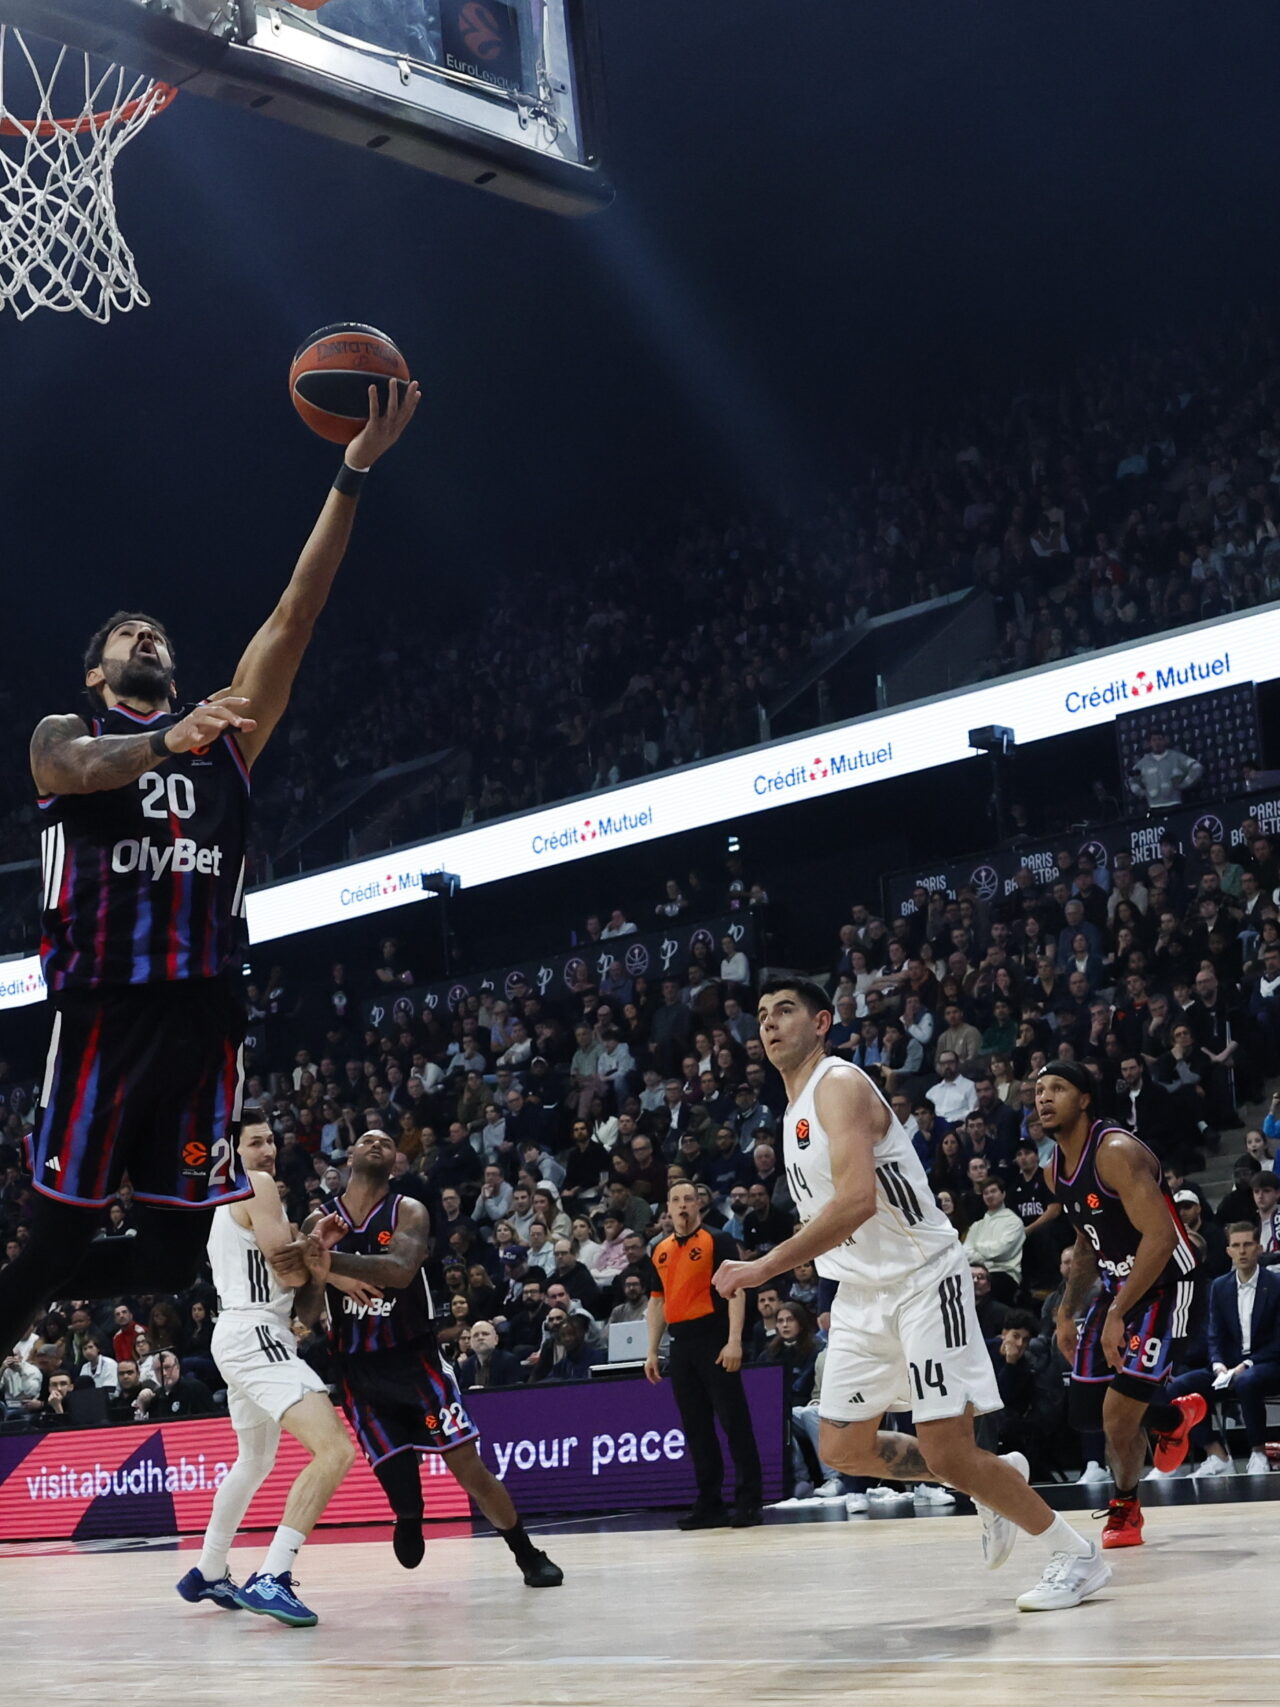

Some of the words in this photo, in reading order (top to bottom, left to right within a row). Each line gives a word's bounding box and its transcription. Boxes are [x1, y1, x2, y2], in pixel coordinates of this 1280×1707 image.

[1065, 679, 1128, 713] Crédit
[1156, 652, 1230, 690] Mutuel
[754, 765, 807, 795] Crédit
[830, 742, 893, 775] Mutuel
[138, 771, 196, 819] 20
[532, 826, 578, 854] Crédit
[599, 805, 652, 837] Mutuel
[111, 836, 222, 881] OlyBet
[340, 881, 380, 905] Crédit
[786, 1163, 813, 1202] 14
[1083, 1223, 1100, 1251] 9
[1141, 1337, 1162, 1368] 9
[909, 1358, 948, 1400] 14
[438, 1402, 470, 1437] 22
[492, 1435, 578, 1481] your
[592, 1428, 686, 1475] pace
